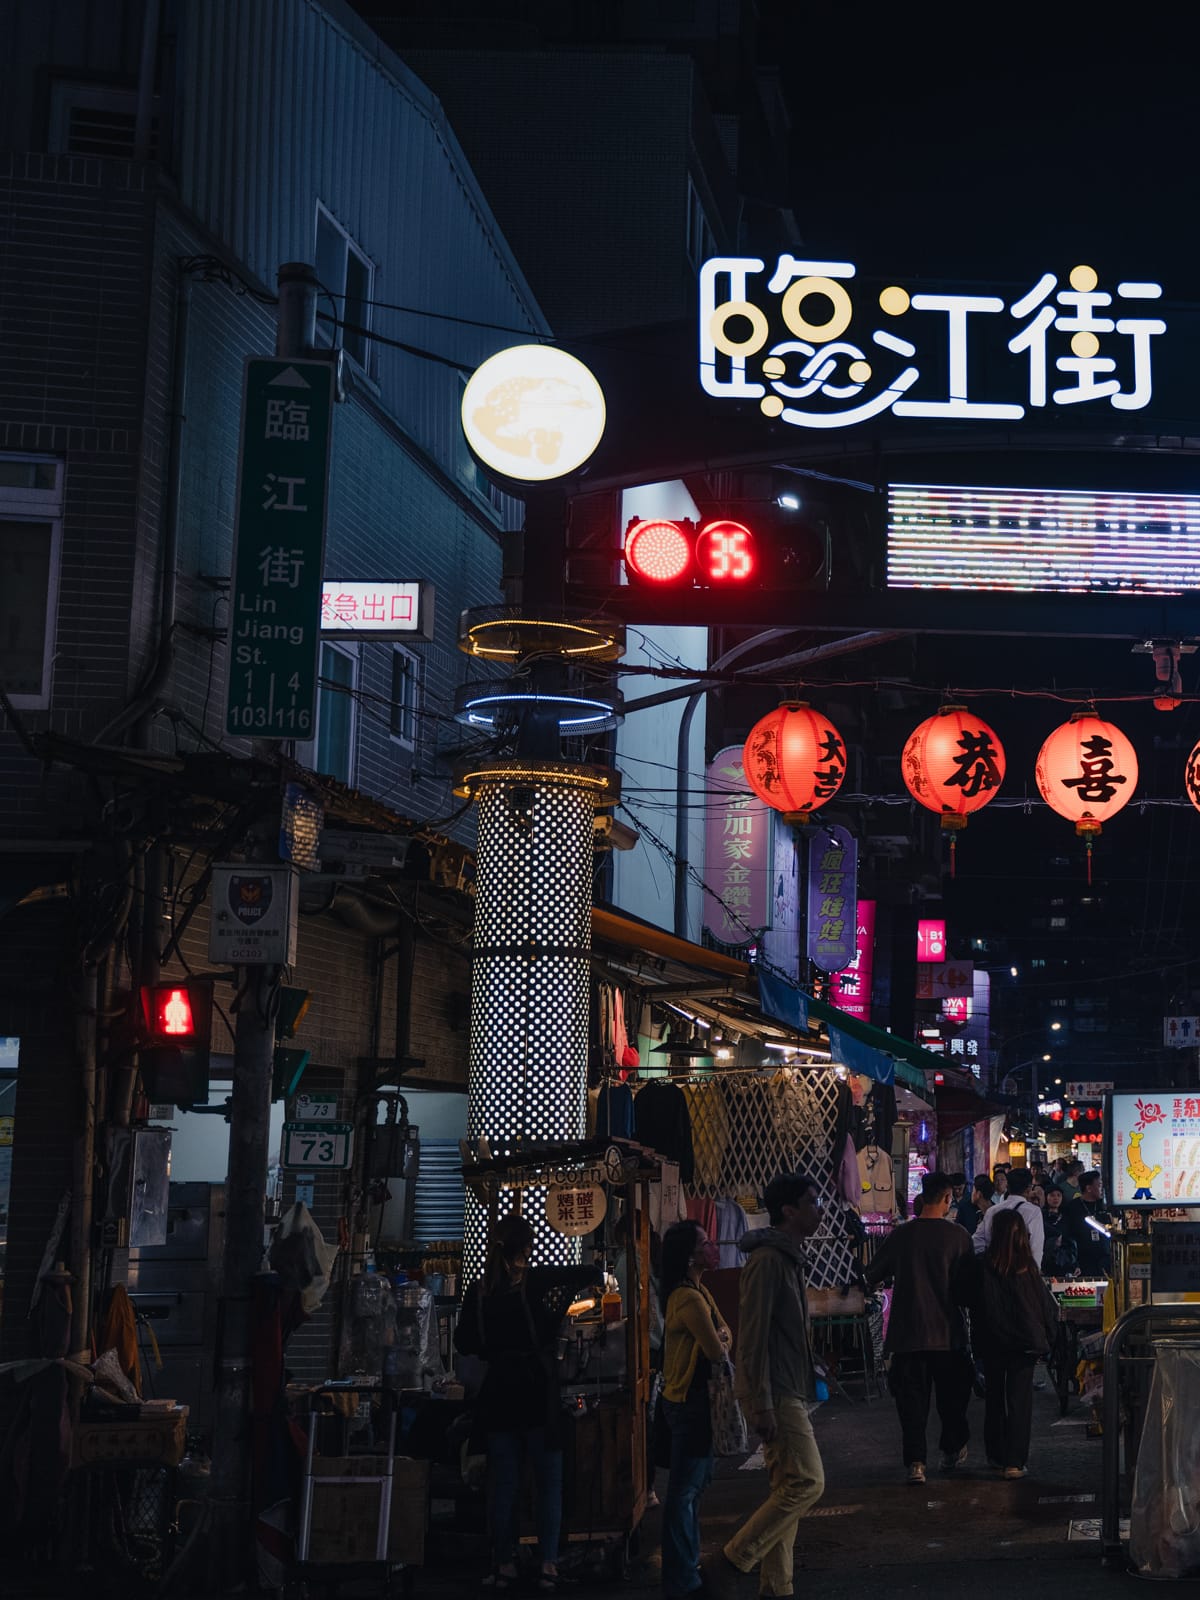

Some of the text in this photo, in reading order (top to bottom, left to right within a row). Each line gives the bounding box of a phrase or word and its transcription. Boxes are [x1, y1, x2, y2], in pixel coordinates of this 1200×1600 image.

[699, 254, 1167, 429] 臨江街
[256, 399, 311, 588] 臨江街
[711, 531, 752, 577] 35
[239, 592, 277, 614] Lin
[236, 618, 304, 645] Jiang
[235, 645, 268, 665] St.
[244, 668, 254, 689] 1
[287, 671, 302, 691] 4
[230, 704, 267, 728] 103
[275, 707, 311, 730] 116
[813, 730, 846, 798] 大吉
[946, 730, 1002, 797] 恭
[1062, 735, 1126, 802] 喜
[818, 850, 846, 941] 瘋狂娃娃
[238, 906, 262, 917] POLICE
[930, 931, 943, 940] B1
[312, 1104, 329, 1117] 73
[301, 1140, 334, 1162] 73
[555, 1167, 602, 1184] corn
